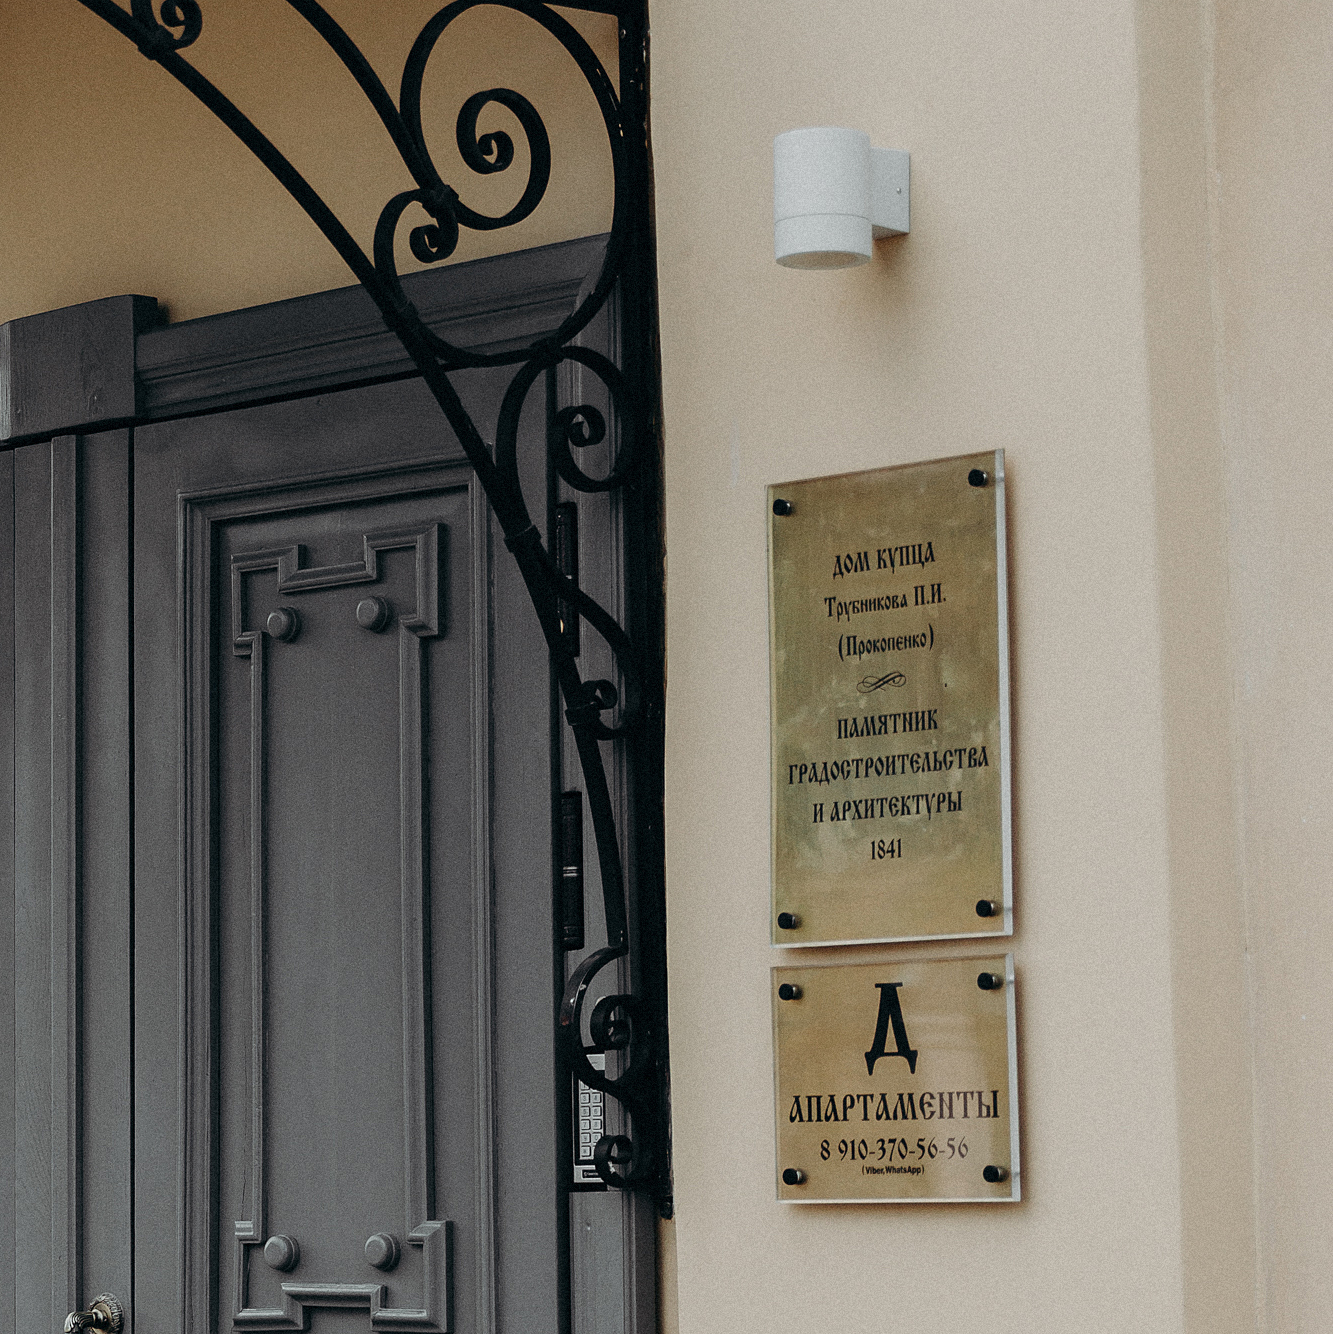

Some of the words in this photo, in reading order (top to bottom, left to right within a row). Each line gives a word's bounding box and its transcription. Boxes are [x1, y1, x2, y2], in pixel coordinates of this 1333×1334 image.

[832, 550, 871, 580] ДОМ
[876, 541, 936, 574] КУПЦА
[824, 596, 908, 623] Трубникова
[913, 582, 947, 607] П.И.
[838, 622, 934, 662] (Прокопенко)
[836, 708, 938, 740] ПАМЯТНИК
[787, 745, 990, 787] ГРАДОСТРОИТЕЛЬСТВА
[812, 802, 824, 824] И
[830, 790, 963, 821] АРХИТЕКТУРЫ
[870, 837, 902, 860] 1841
[864, 982, 918, 1076] Д
[789, 1089, 1001, 1123] АПАРТАМЕНТЫ
[819, 1138, 831, 1162] 8
[837, 1135, 969, 1162] 910-370-56-56
